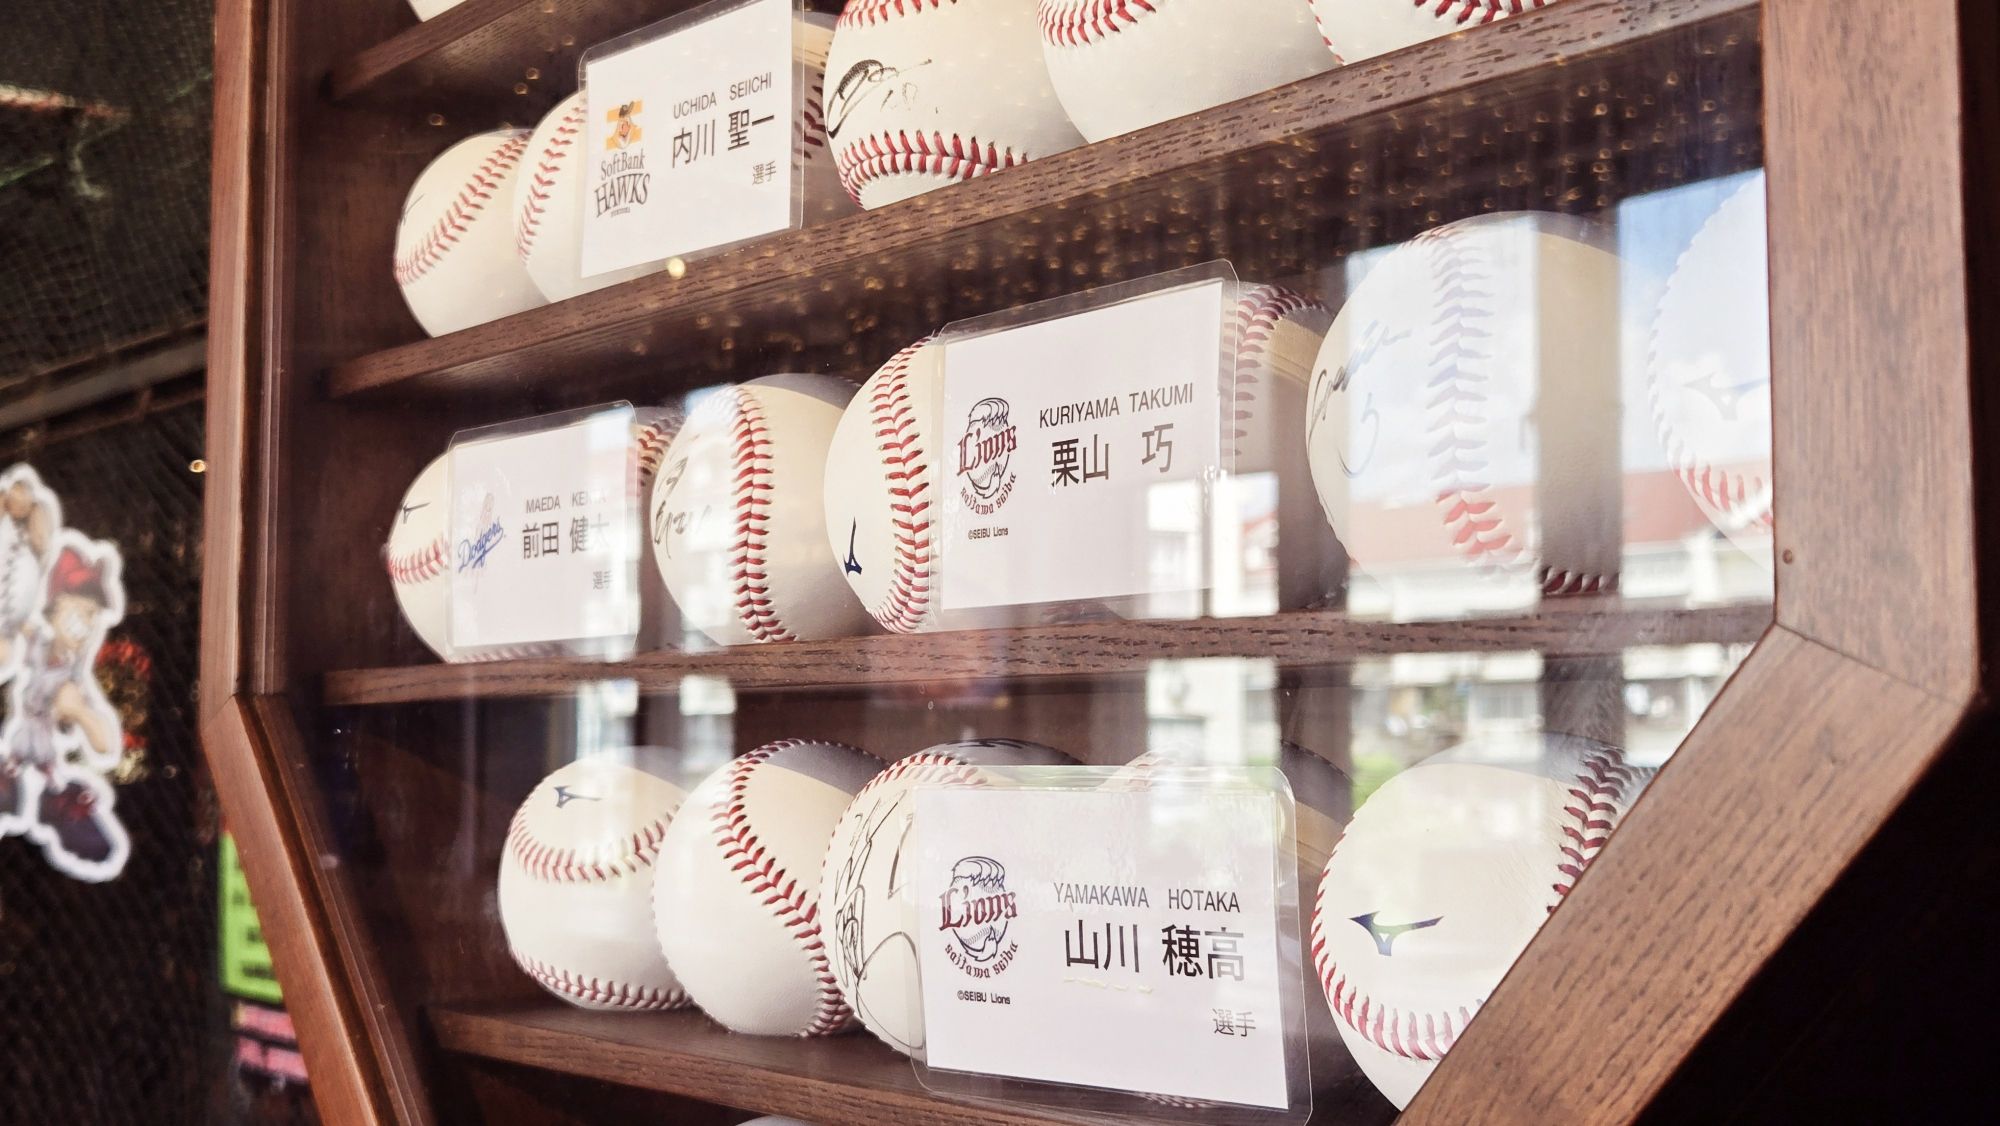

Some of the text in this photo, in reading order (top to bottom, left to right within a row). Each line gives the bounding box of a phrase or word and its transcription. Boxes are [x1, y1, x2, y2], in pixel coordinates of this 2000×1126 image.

[673, 71, 773, 119] UCHIDA SEIICHI
[672, 108, 775, 169] 内川 聖一
[601, 148, 646, 180] SoftBank
[752, 160, 777, 185] 選手
[594, 172, 651, 218] HAWKS
[1039, 382, 1193, 429] KURIYAMA TAKUMI
[956, 425, 1018, 477] Lions
[1050, 422, 1175, 488] 栗山 巧
[525, 494, 561, 514] MAEDA
[458, 515, 504, 574] Dodgers
[521, 521, 560, 560] 前田
[993, 526, 1009, 538] Lions
[938, 885, 1018, 931] Lions
[1053, 882, 1241, 914] YAMAKAWA HOTAKA
[1064, 919, 1245, 982] 山川 穂高
[990, 993, 1012, 1005] Lions
[1211, 1008, 1257, 1038] 選手
